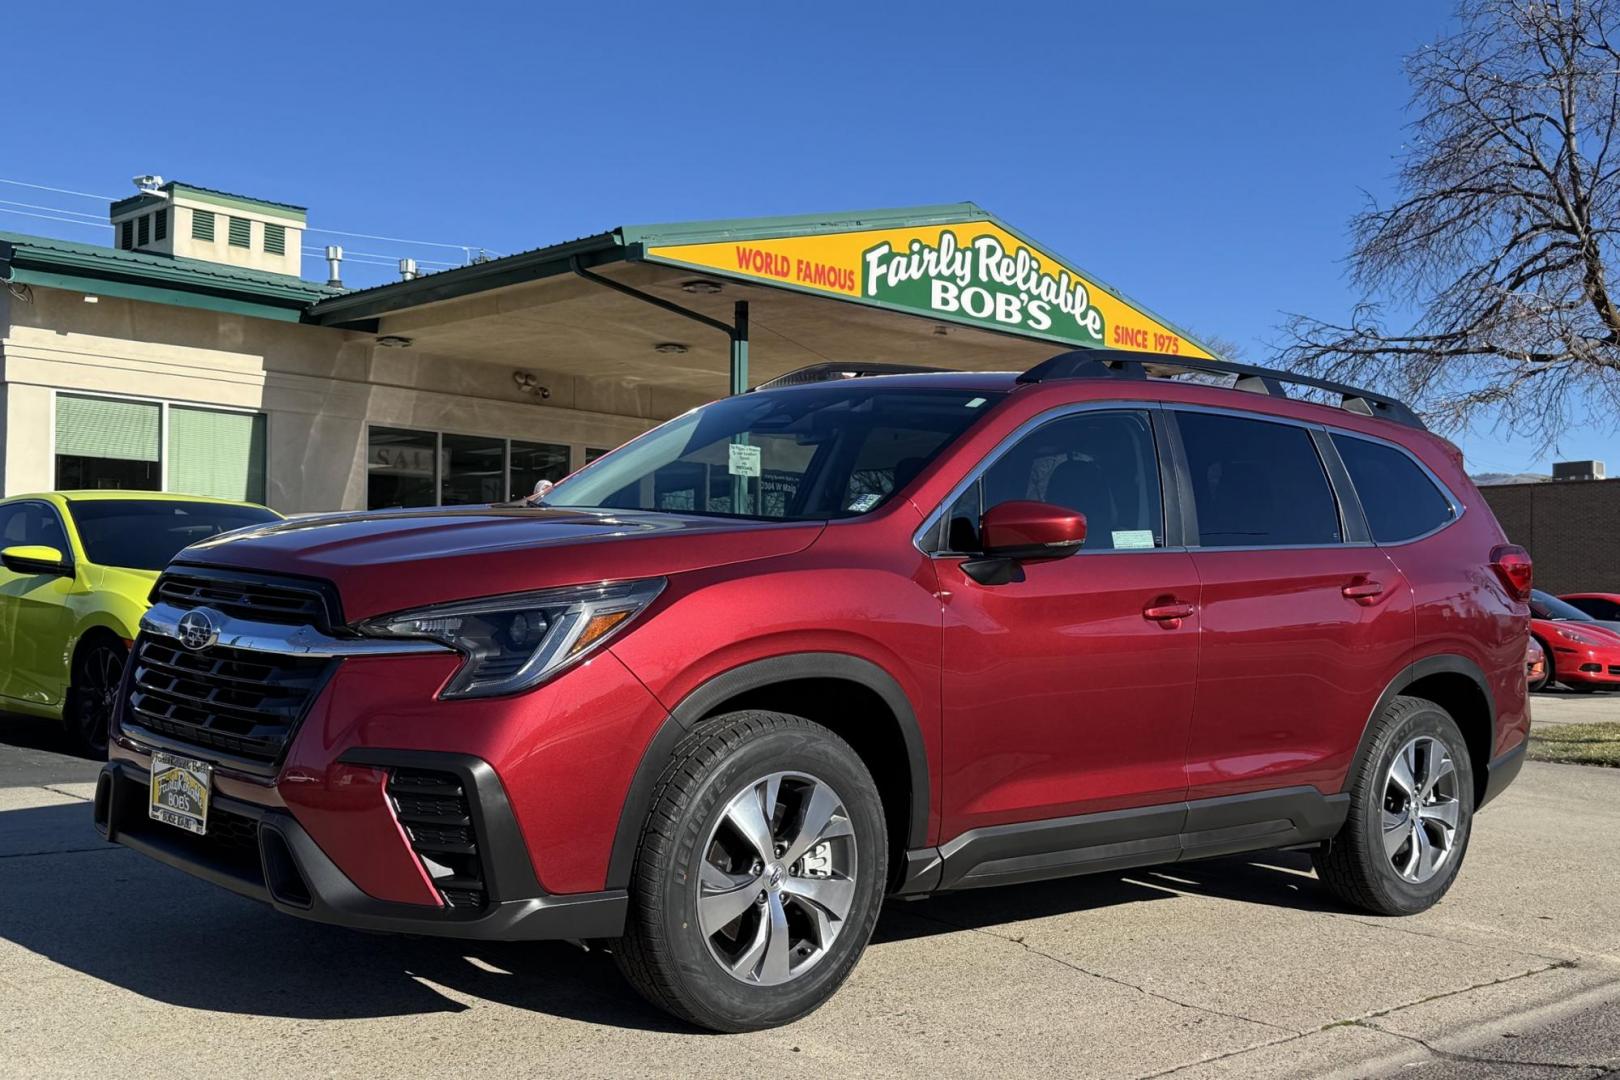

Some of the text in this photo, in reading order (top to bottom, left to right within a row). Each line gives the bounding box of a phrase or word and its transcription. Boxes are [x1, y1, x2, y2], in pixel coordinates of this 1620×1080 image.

[735, 245, 856, 291] WORLD FAMOUS
[865, 232, 1103, 339] Fairly Reliable
[931, 278, 1052, 331] BOB'S
[1114, 324, 1180, 354] SINCE 1975
[168, 792, 190, 812] BOB'S
